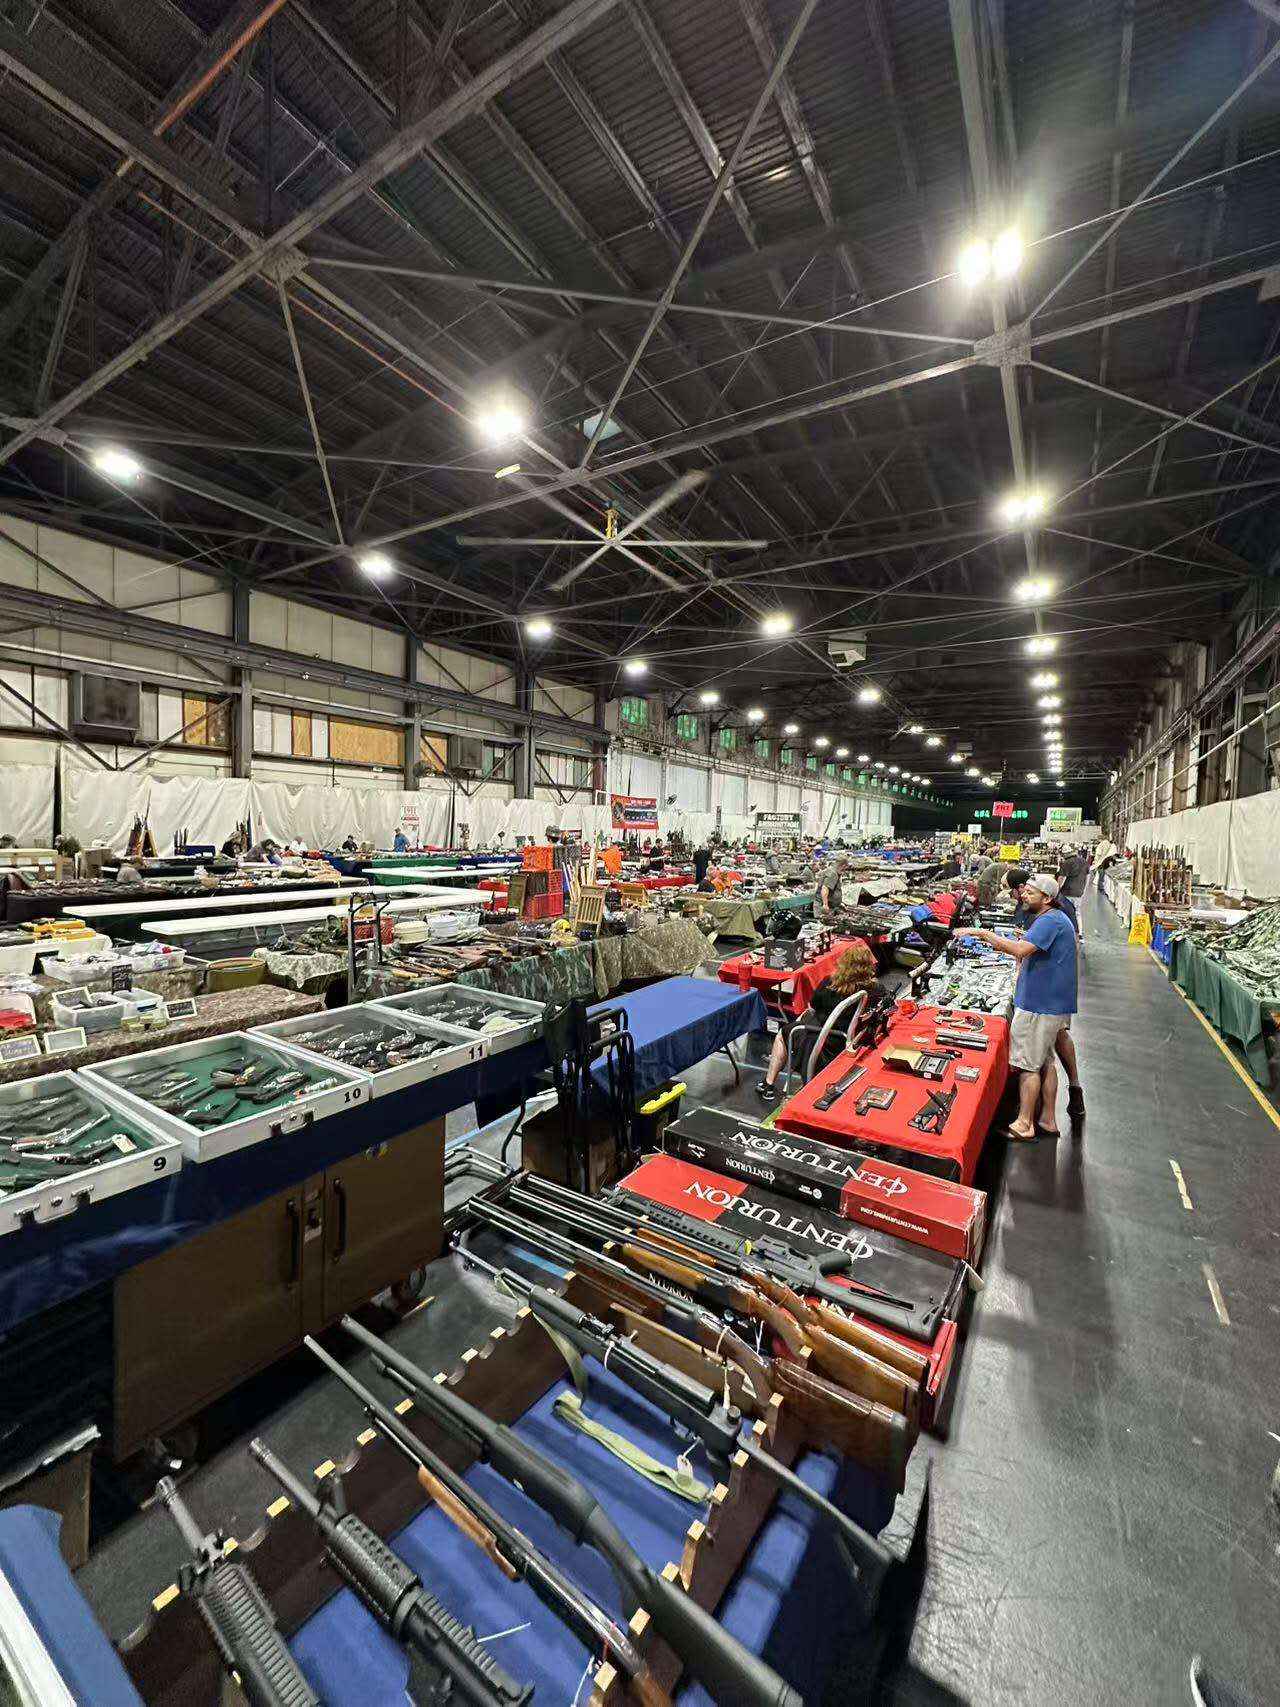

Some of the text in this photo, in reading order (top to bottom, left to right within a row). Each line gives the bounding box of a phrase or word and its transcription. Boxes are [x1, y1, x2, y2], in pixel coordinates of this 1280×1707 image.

[469, 1045, 484, 1060] 11
[343, 1087, 361, 1103] 10
[153, 1156, 167, 1172] 9
[725, 1156, 776, 1185] CENTURION
[729, 1130, 908, 1197] CENTURION
[683, 1180, 874, 1264] CENTURION
